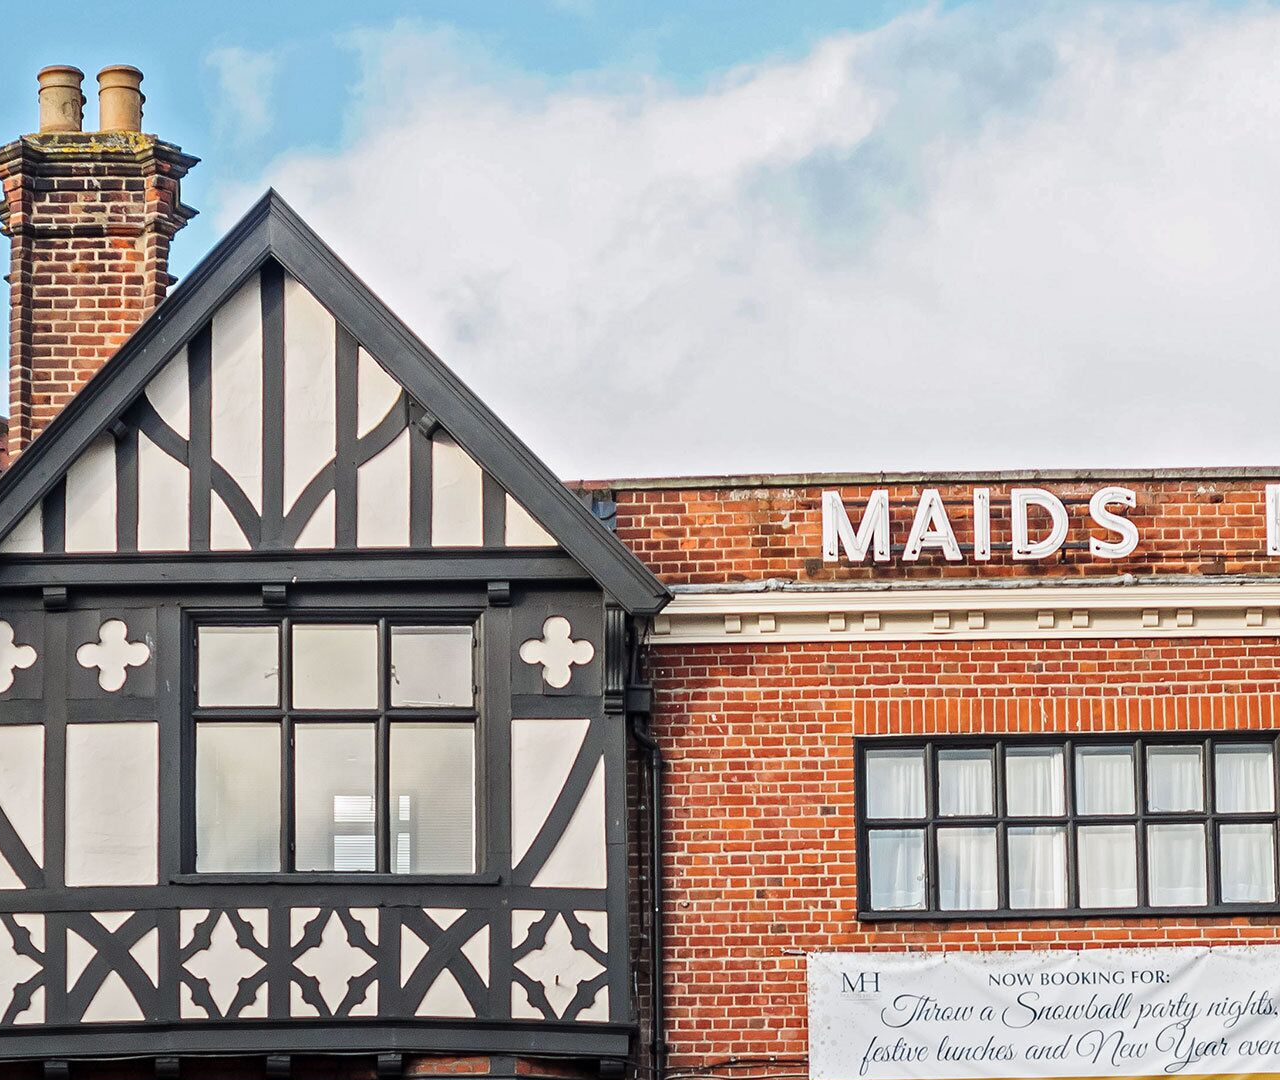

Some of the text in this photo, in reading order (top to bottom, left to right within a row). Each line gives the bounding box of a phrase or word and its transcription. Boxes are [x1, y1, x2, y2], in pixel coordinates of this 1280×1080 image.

[821, 486, 1139, 562] MAIDS
[840, 971, 881, 992] MH
[989, 970, 1170, 986] NOW BOOKING FOR:
[881, 993, 973, 1028] Throw
[980, 1005, 996, 1021] a
[1002, 991, 1133, 1028] Snowball
[1133, 992, 1200, 1029] party
[859, 1035, 929, 1076] festive
[936, 1035, 1017, 1061] lunches
[1025, 1034, 1073, 1060] and
[1076, 1029, 1148, 1067] New
[1155, 1022, 1231, 1073] Year
